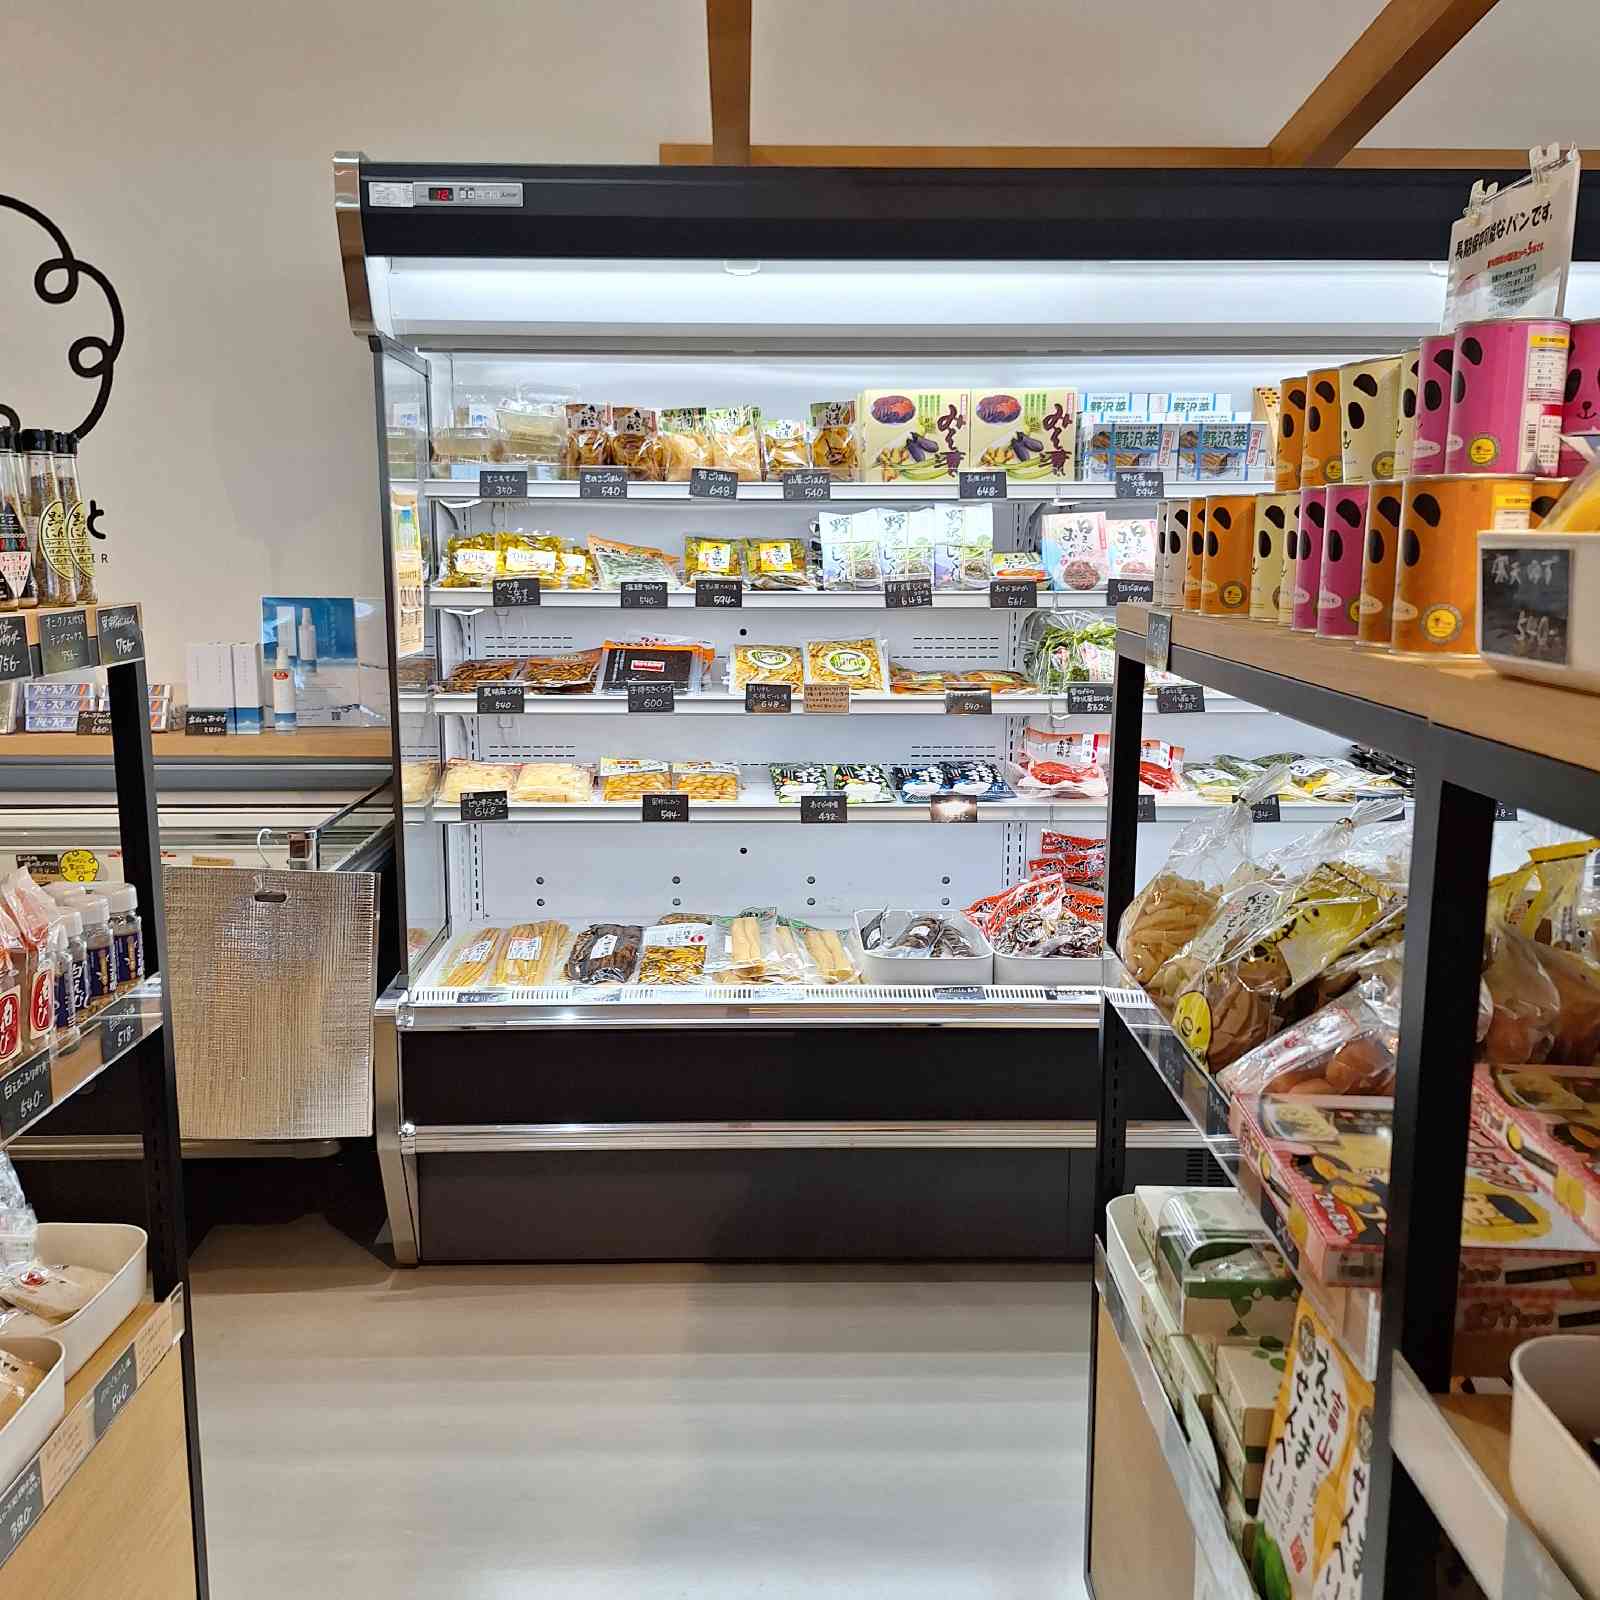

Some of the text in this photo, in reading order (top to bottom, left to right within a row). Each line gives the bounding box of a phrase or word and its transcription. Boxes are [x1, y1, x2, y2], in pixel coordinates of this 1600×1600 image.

[1090, 401, 1127, 412] 野沢菜
[1174, 401, 1210, 412] 野沢菜
[1115, 431, 1160, 448] 野沢菜
[1203, 431, 1248, 448] 野沢菜
[1269, 1369, 1309, 1493] せんべい
[1316, 1389, 1346, 1468] 富山
